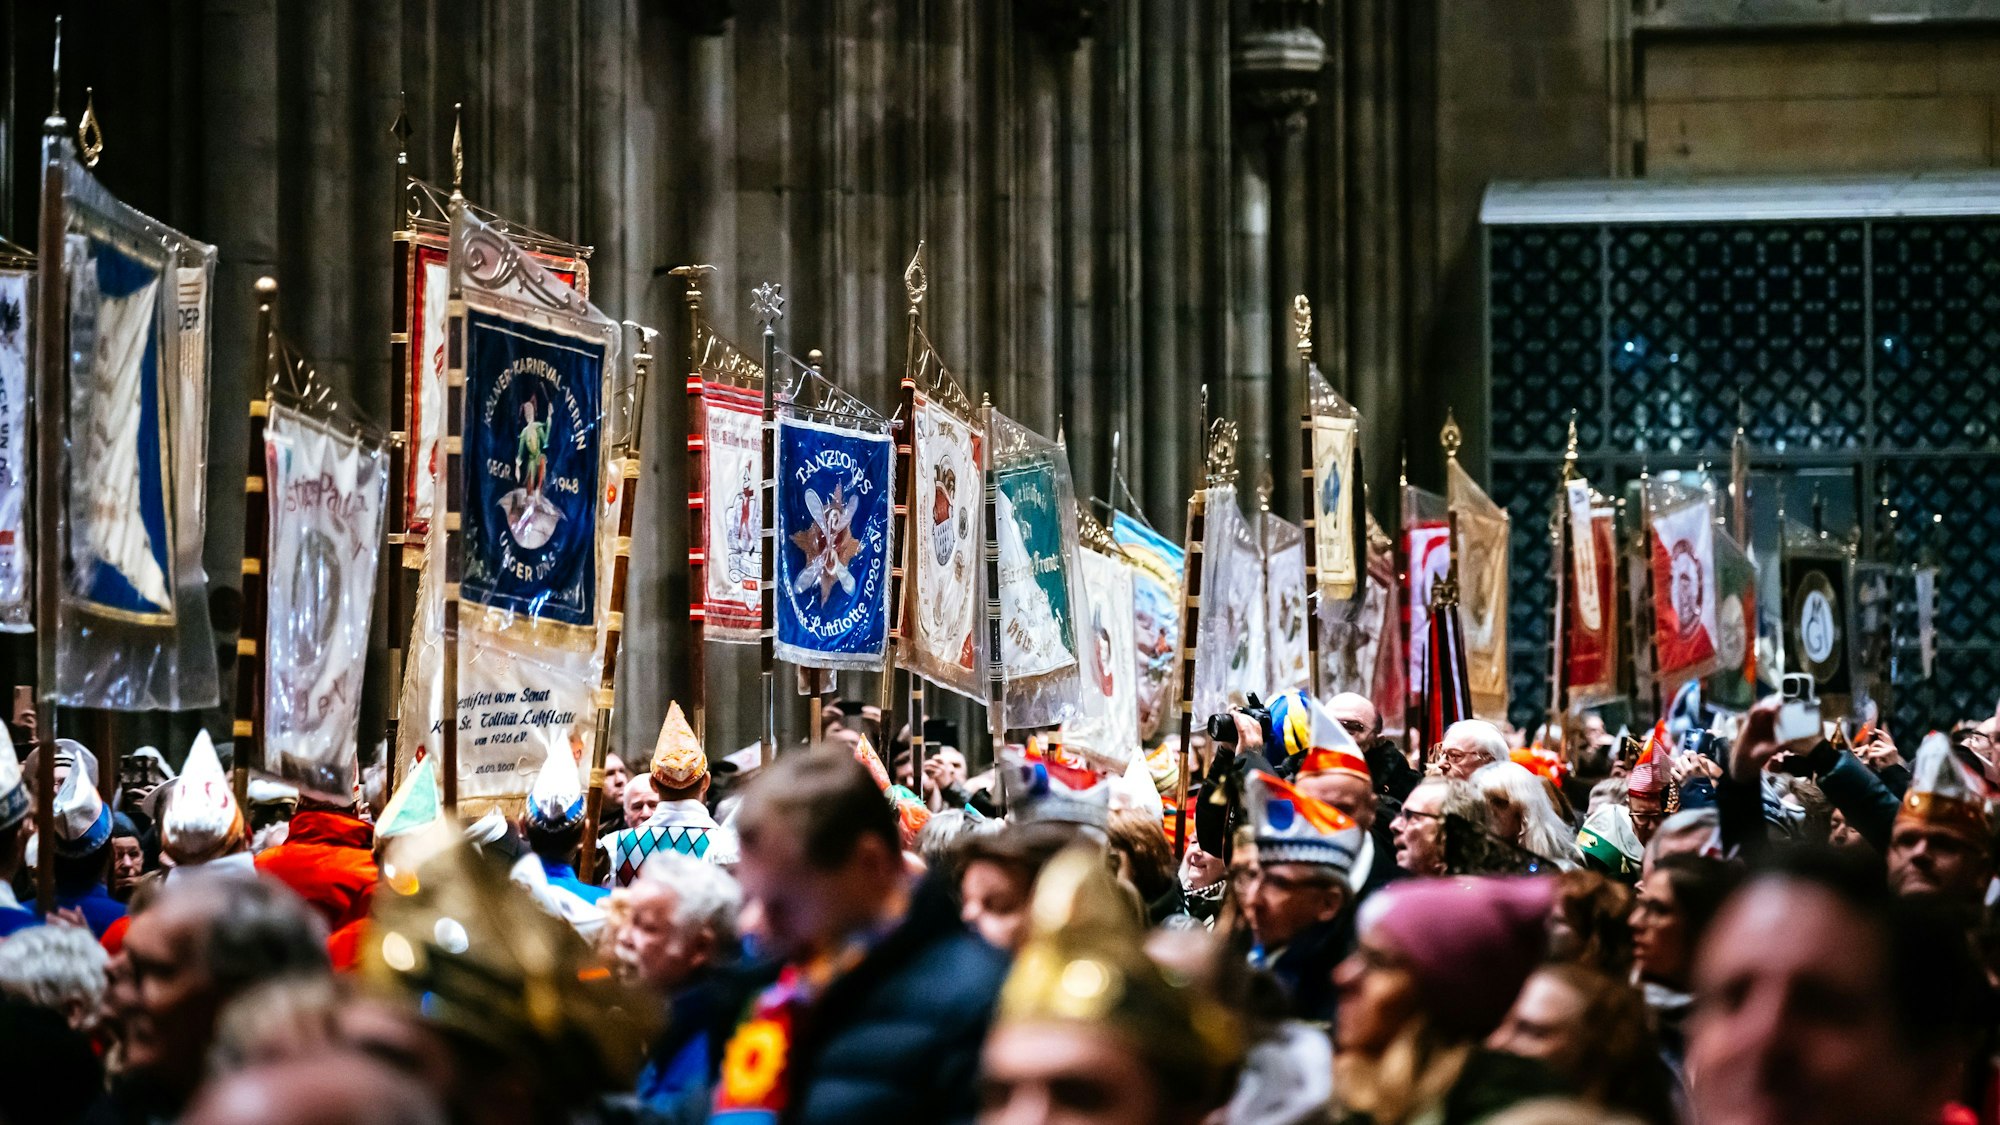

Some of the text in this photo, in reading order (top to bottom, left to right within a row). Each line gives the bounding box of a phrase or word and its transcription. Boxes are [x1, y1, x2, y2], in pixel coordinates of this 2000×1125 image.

[795, 449, 873, 495] TANZCORPS
[554, 476, 579, 494] 1948
[863, 558, 881, 600] 1926
[457, 687, 550, 710] estiftet vom Senat
[480, 711, 518, 728] Tollität
[520, 709, 577, 728] Luftflotte
[490, 732, 513, 744] 1926
